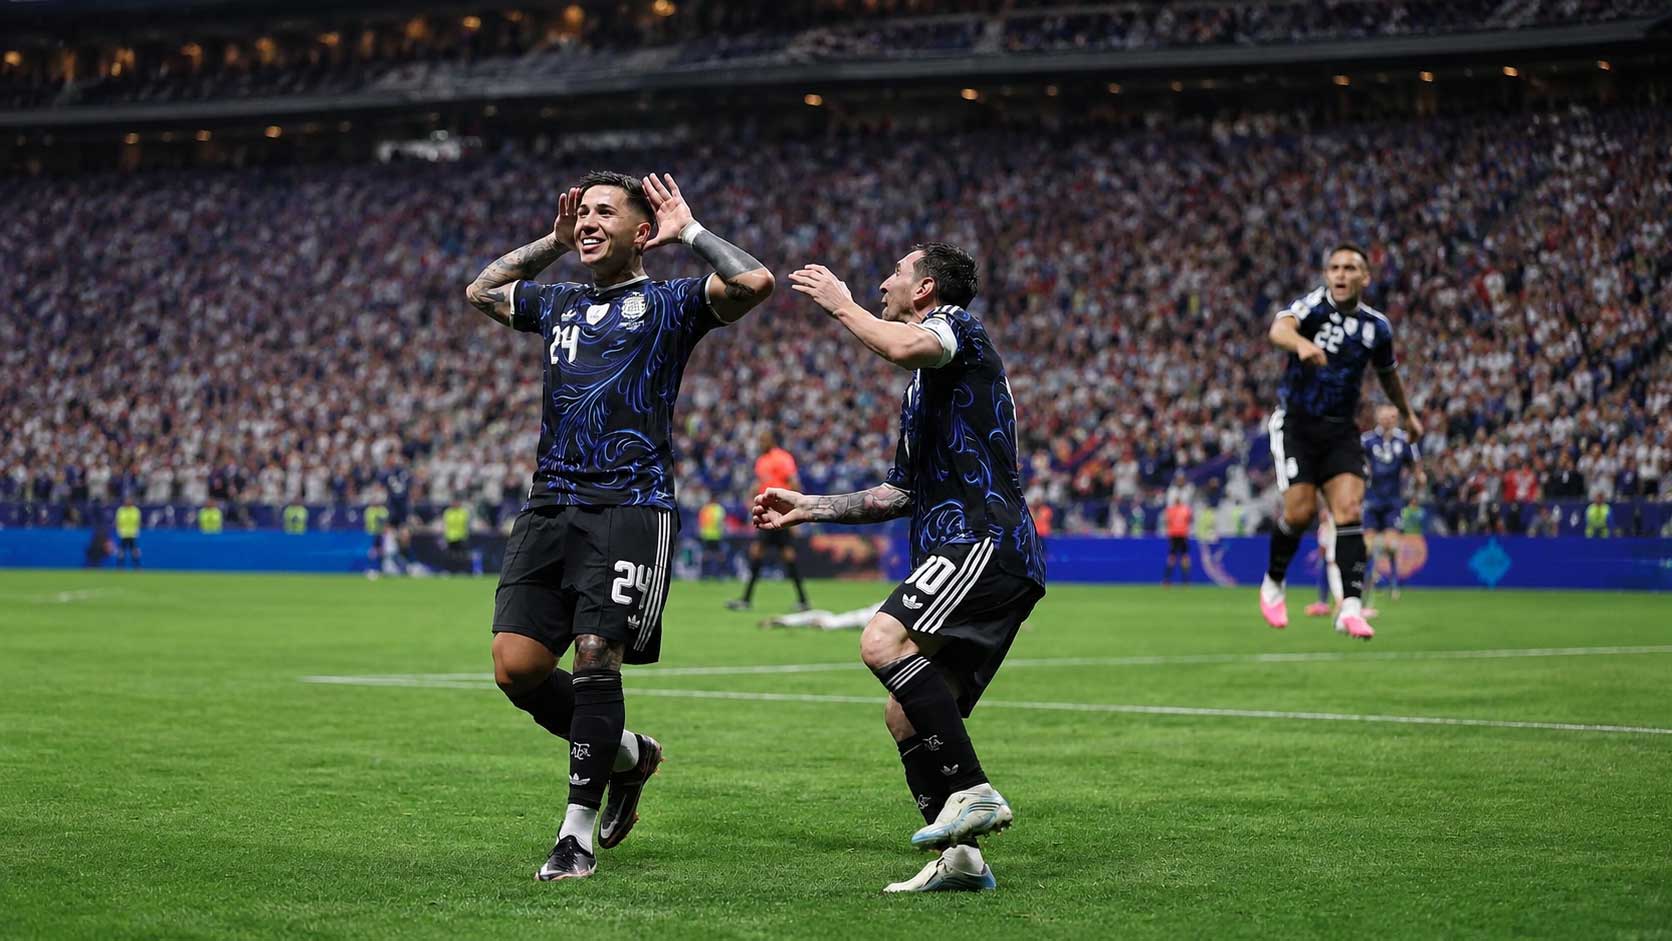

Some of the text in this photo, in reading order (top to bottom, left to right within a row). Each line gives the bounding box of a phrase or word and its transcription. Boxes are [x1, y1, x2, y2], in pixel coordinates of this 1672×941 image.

[550, 325, 580, 364] 24
[1314, 322, 1345, 354] 22
[611, 560, 652, 610] 24
[905, 555, 956, 595] 10
